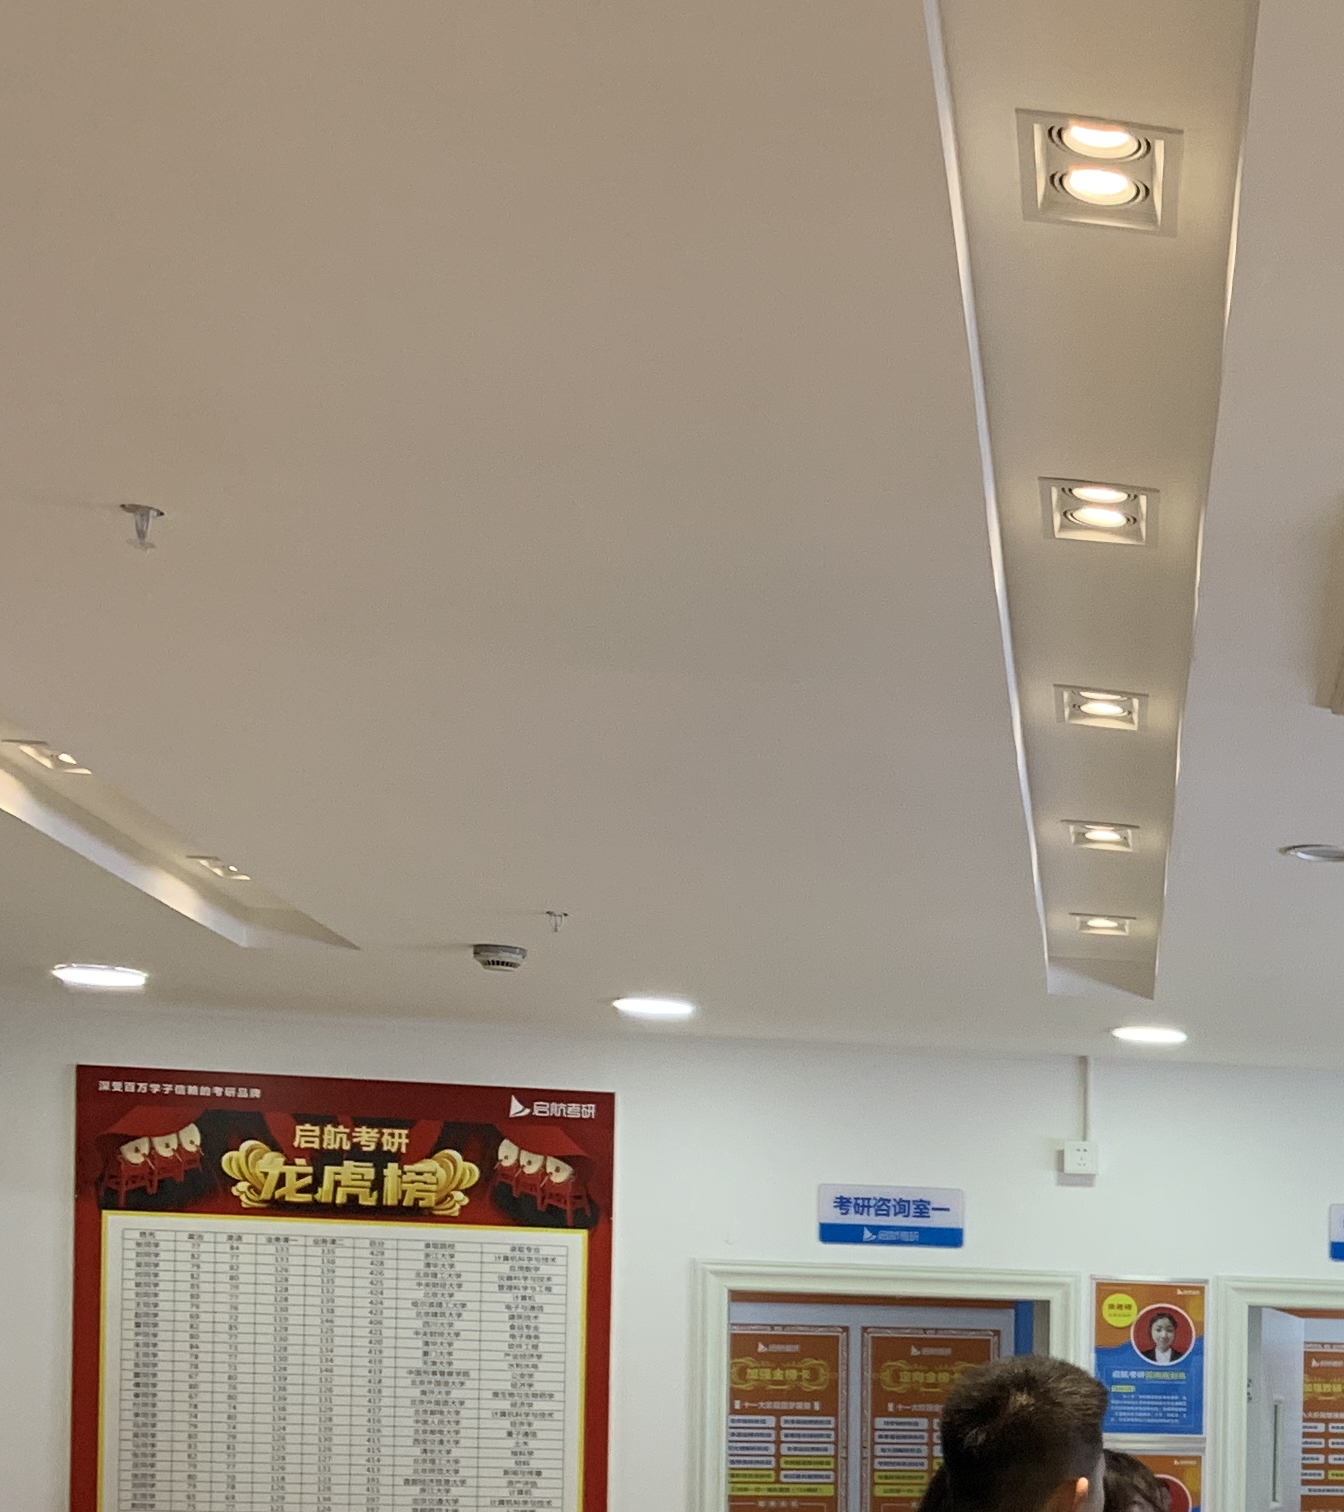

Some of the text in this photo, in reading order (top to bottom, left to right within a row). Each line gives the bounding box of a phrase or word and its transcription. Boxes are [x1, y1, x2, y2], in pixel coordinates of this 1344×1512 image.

[532, 1100, 597, 1120] 启航考研
[292, 1123, 410, 1154] 启航考研
[259, 1156, 441, 1208] 龙虎榜
[832, 1195, 951, 1219] 考研咨询室一
